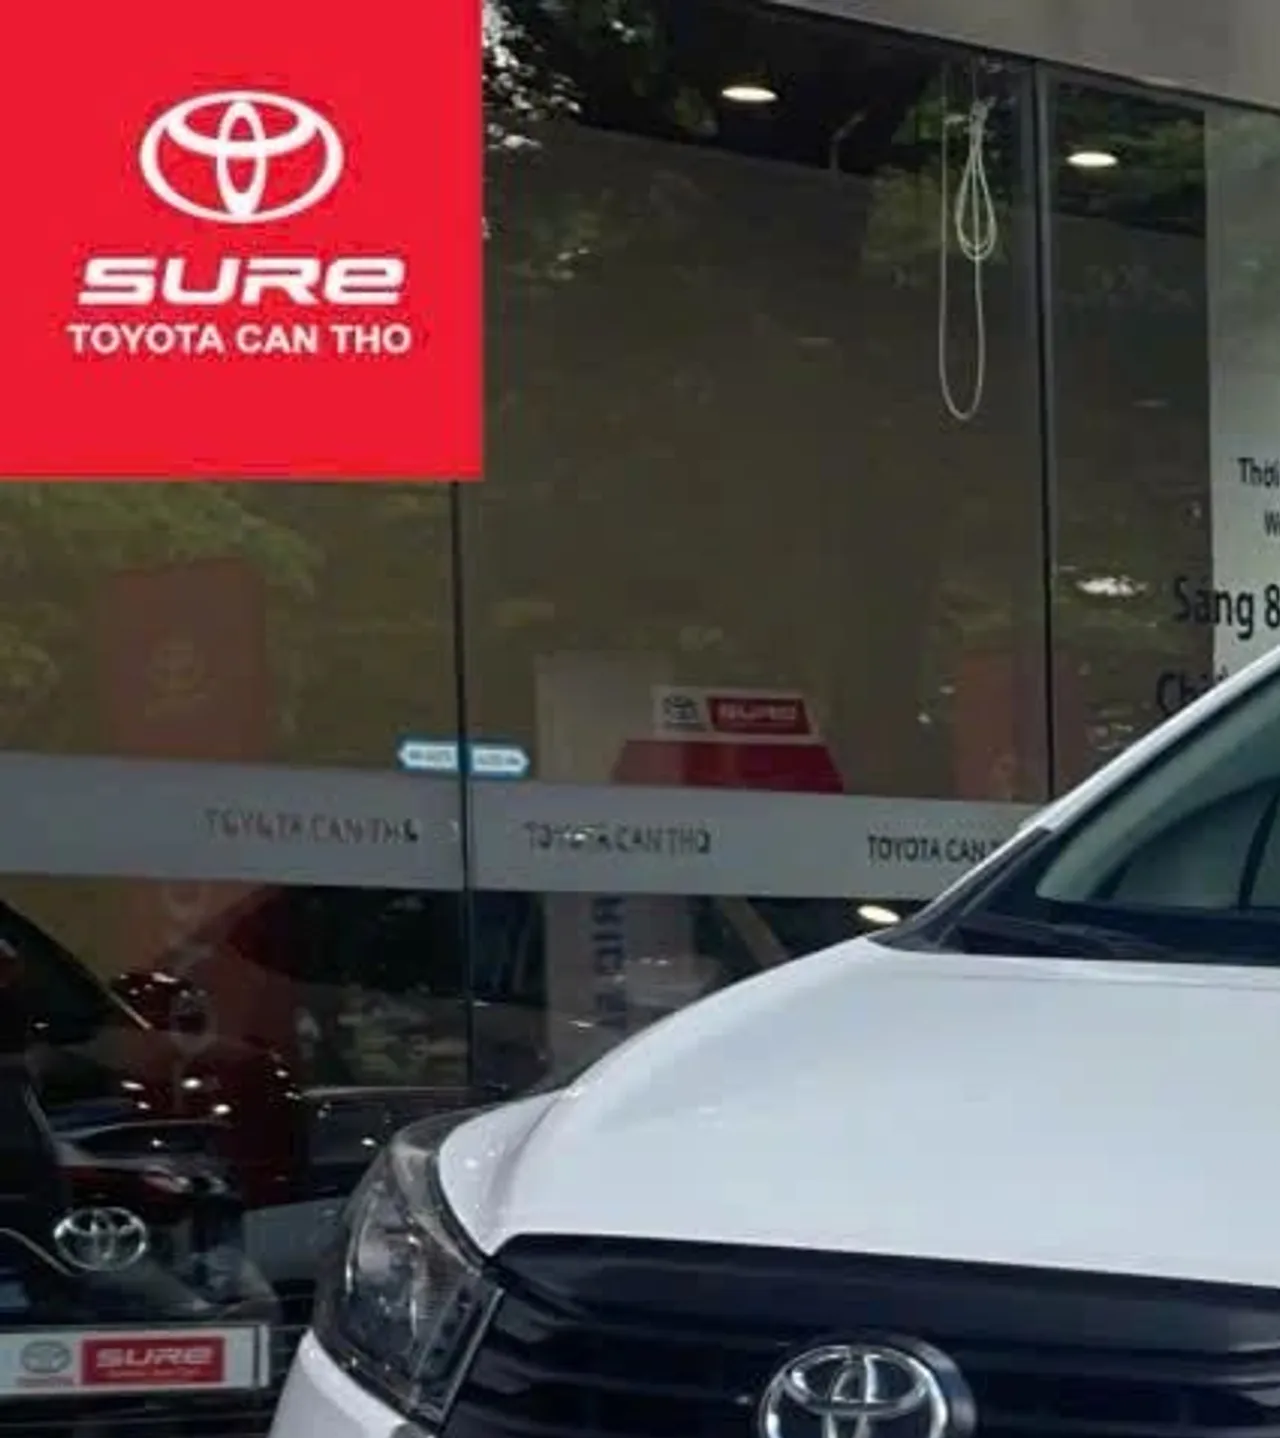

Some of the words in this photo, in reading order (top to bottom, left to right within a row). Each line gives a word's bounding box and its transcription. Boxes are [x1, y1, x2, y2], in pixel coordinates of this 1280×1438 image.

[613, 823, 662, 854] CAN
[664, 824, 712, 856] THO
[867, 835, 942, 864] TOYOTA
[945, 837, 987, 865] CAN
[96, 1346, 215, 1368] SURE
